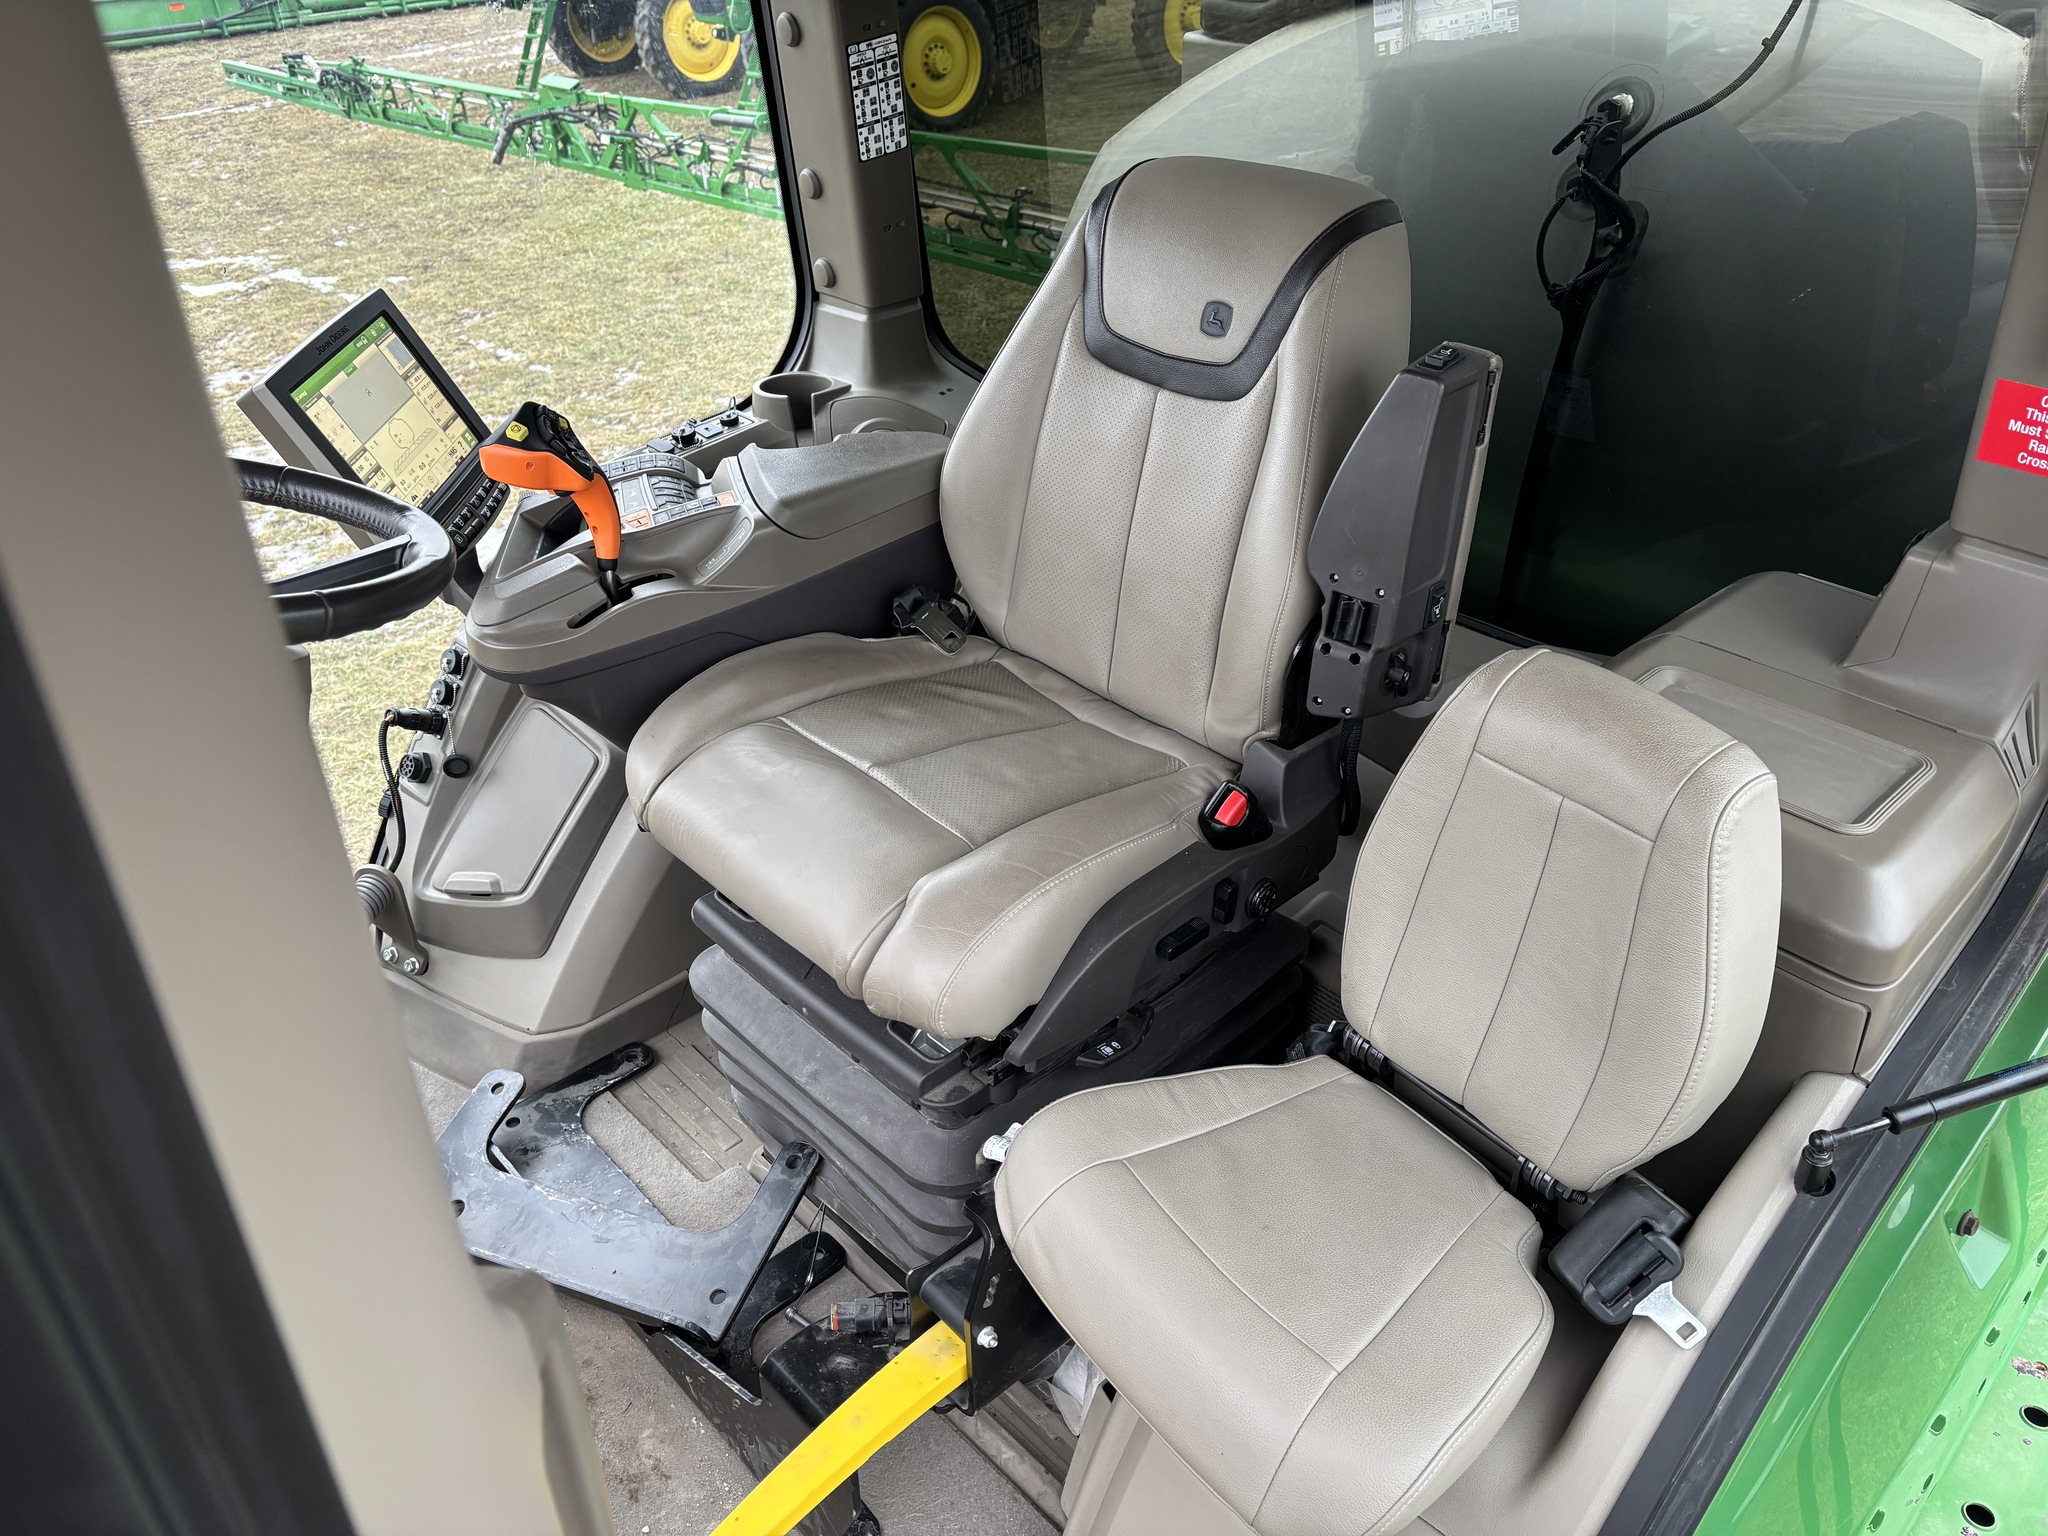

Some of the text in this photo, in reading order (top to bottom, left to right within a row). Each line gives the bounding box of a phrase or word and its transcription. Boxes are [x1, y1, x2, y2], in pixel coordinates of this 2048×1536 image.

[316, 325, 350, 356] JOHN DEERE
[2008, 419, 2042, 438] Must
[2017, 452, 2048, 470] Cros
